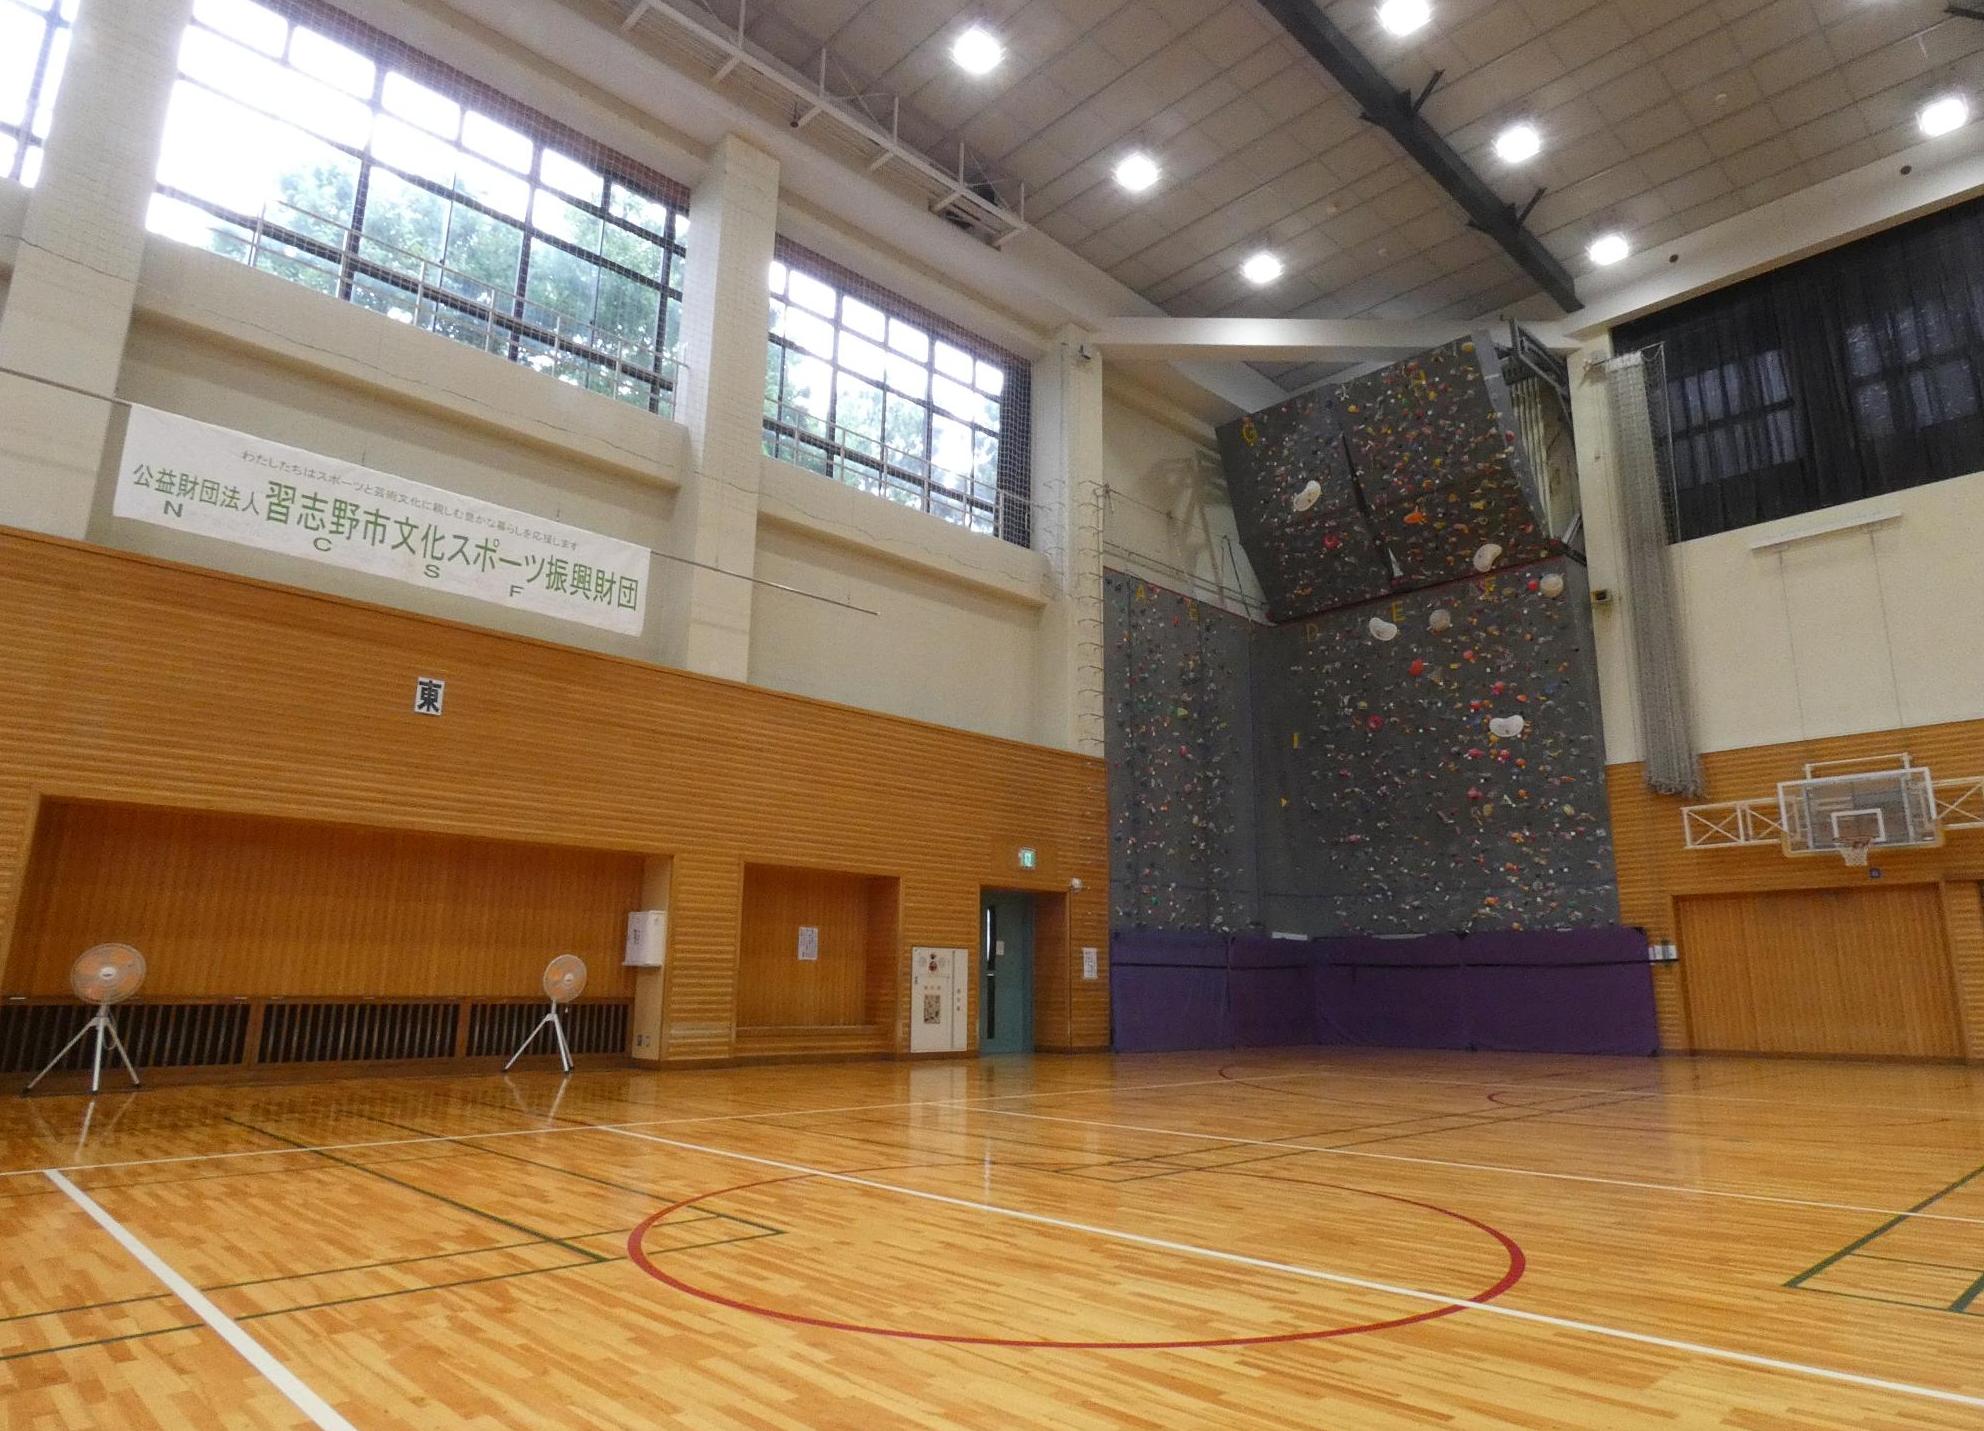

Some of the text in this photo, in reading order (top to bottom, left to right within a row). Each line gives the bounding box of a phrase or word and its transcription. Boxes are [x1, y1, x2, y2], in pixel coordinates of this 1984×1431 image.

[163, 500, 525, 597] N C S F
[417, 680, 442, 712] 東
